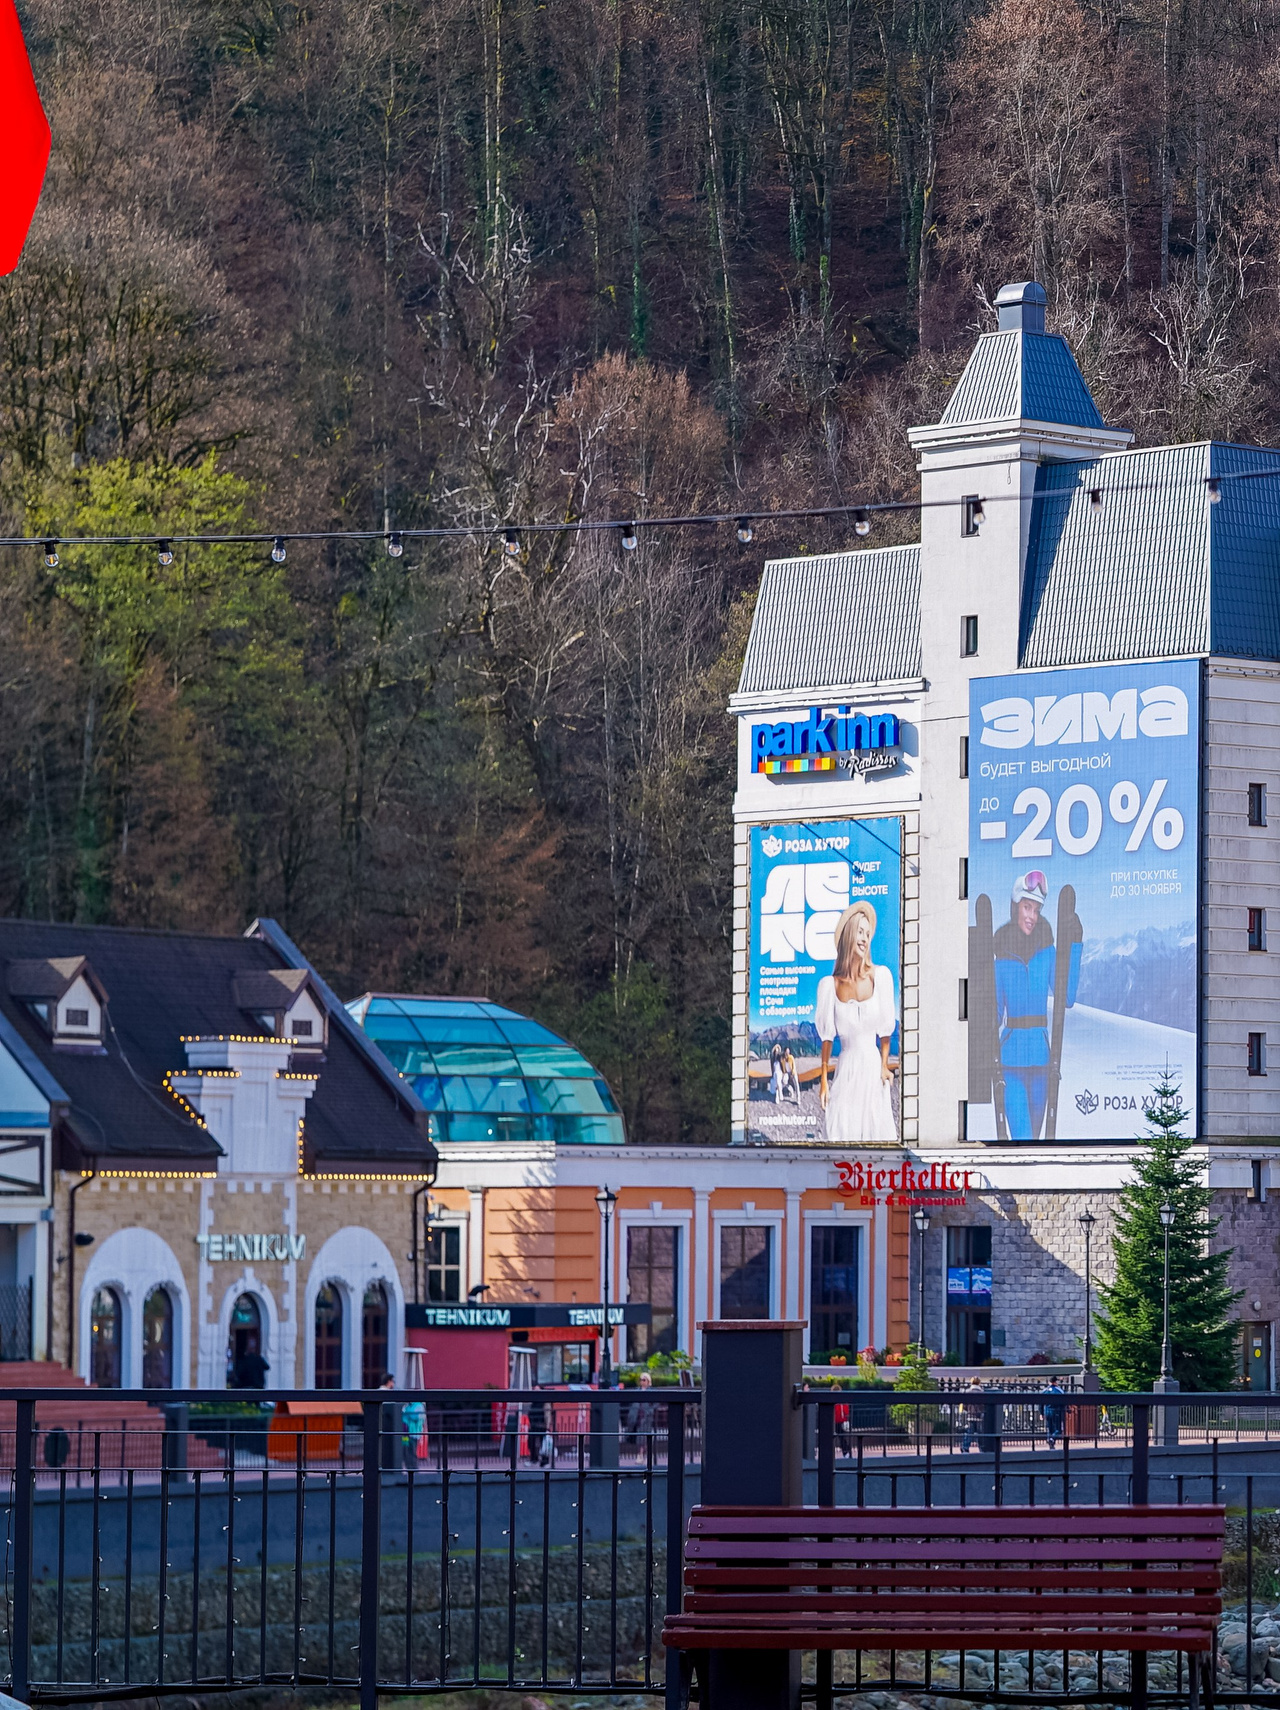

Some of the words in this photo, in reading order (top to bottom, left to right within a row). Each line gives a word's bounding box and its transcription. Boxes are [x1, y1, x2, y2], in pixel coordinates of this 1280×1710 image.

[751, 706, 836, 774] park
[837, 705, 899, 751] inn
[839, 757, 849, 770] by
[848, 752, 899, 779] Radisson
[980, 778, 1184, 859] -20%
[785, 839, 812, 853] РОЗА
[814, 836, 850, 852] ХУТОР
[1110, 871, 1130, 882] ПРИ
[1132, 869, 1178, 881] ПОКУПКЕ
[1110, 885, 1126, 898] ДО
[1128, 884, 1141, 896] 30
[1142, 882, 1182, 895] НОЯБРЯ
[1104, 1096, 1137, 1110] РОЗА
[833, 1161, 975, 1198] Bierkeller
[860, 1195, 881, 1206] Bar
[885, 1194, 895, 1206] &
[898, 1195, 967, 1206] Restaurant
[196, 1234, 306, 1261] TEHNIKUM
[425, 1308, 511, 1326] TEHNIKUM
[568, 1308, 624, 1325] TEHNIUM
